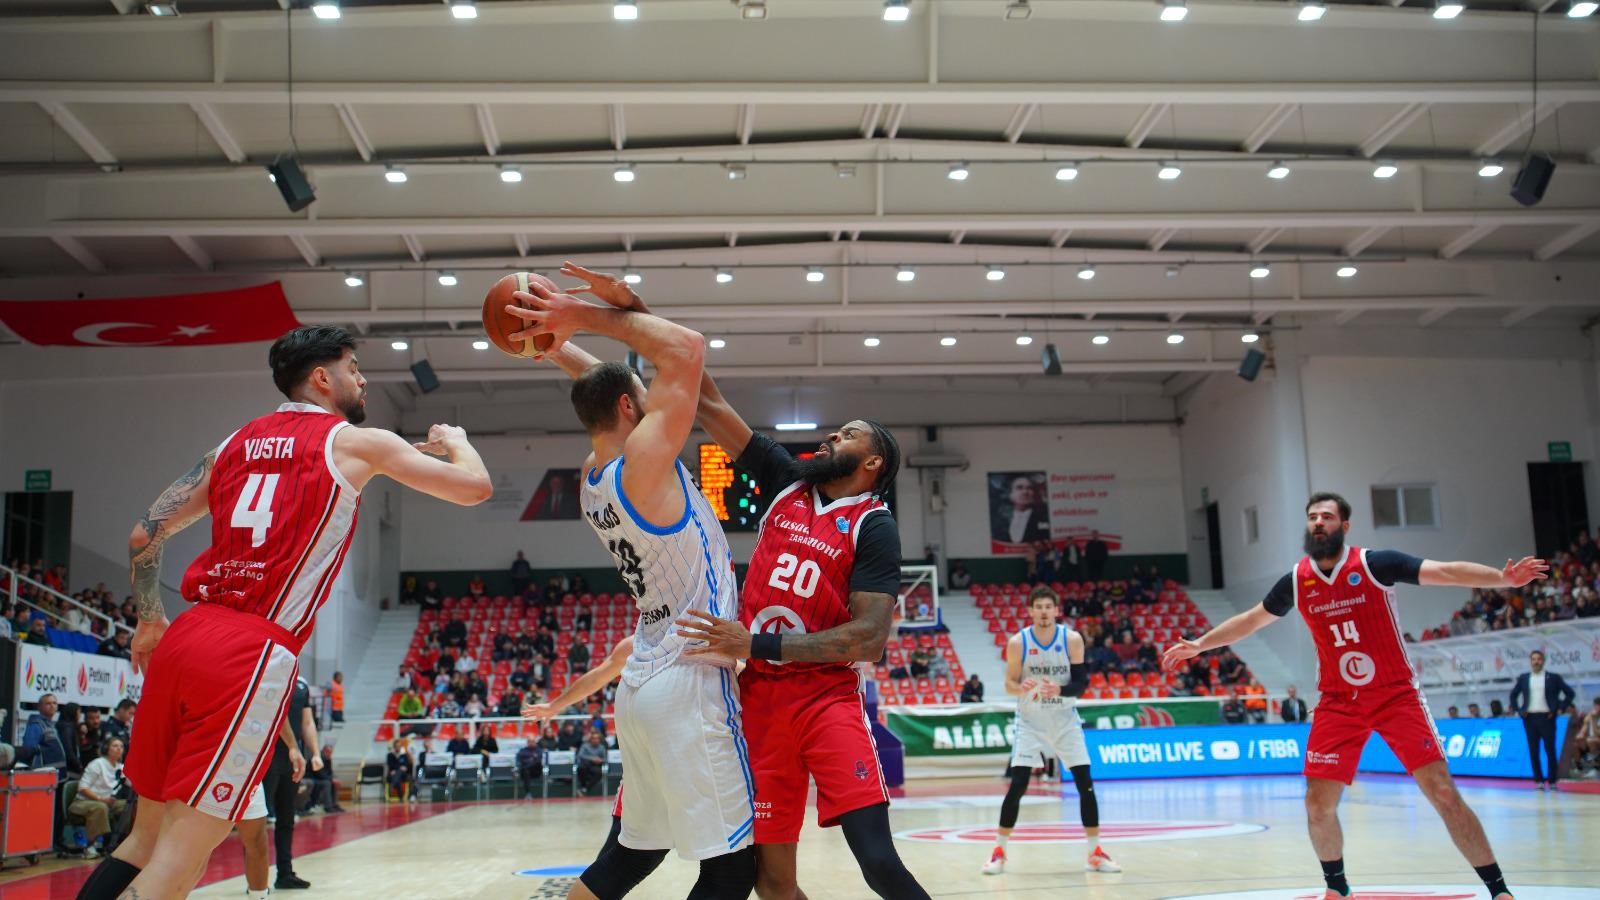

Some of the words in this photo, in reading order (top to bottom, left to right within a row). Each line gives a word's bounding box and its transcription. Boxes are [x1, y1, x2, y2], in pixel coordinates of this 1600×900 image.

[244, 437, 295, 462] YUSTA
[231, 473, 280, 548] 4
[768, 553, 821, 599] 20
[1308, 593, 1366, 614] Casademont
[1329, 620, 1360, 648] 14
[36, 673, 67, 693] SOCAR
[1098, 742, 1162, 765] WATCH
[1165, 741, 1205, 762] LIVE
[1258, 738, 1300, 759] FIBA
